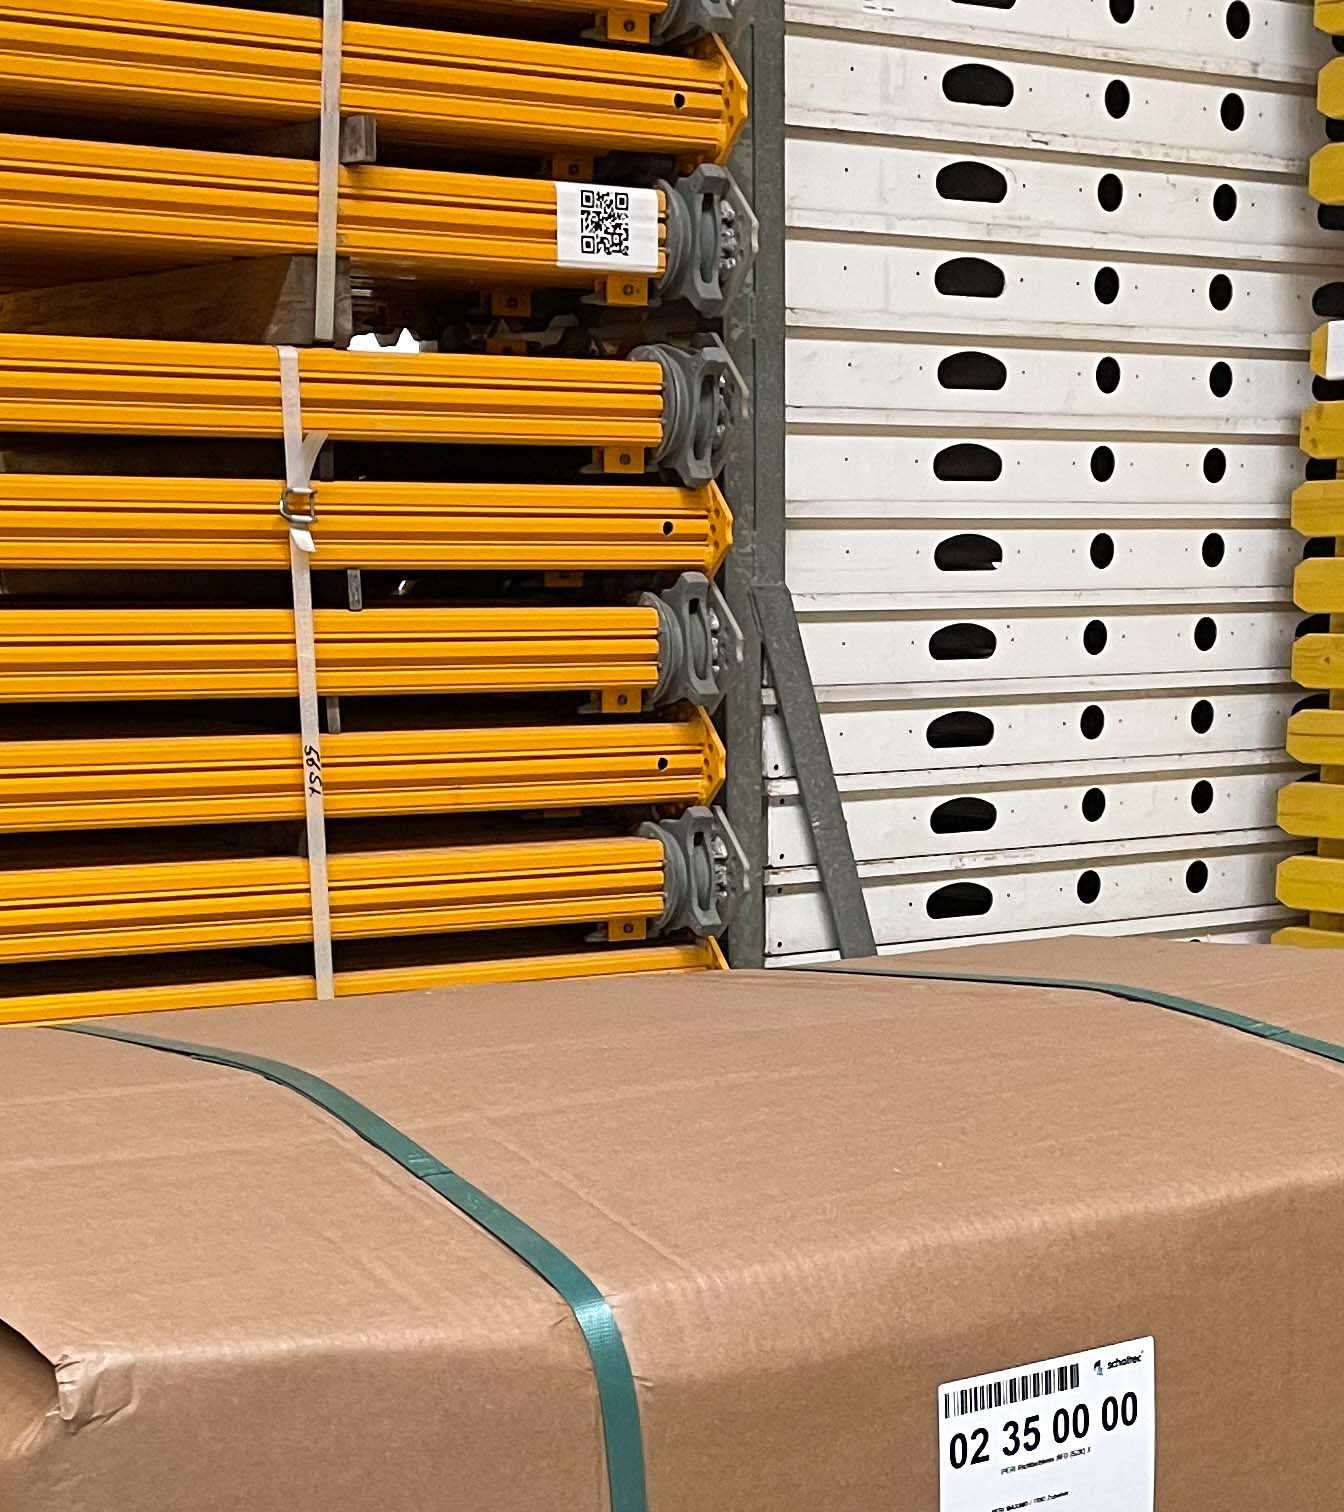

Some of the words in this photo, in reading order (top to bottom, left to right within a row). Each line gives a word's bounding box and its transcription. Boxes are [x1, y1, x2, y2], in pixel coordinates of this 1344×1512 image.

[950, 1427, 990, 1469] 02
[1002, 1415, 1041, 1456] 35
[1053, 1404, 1090, 1443] 00
[1101, 1392, 1138, 1431] 00
